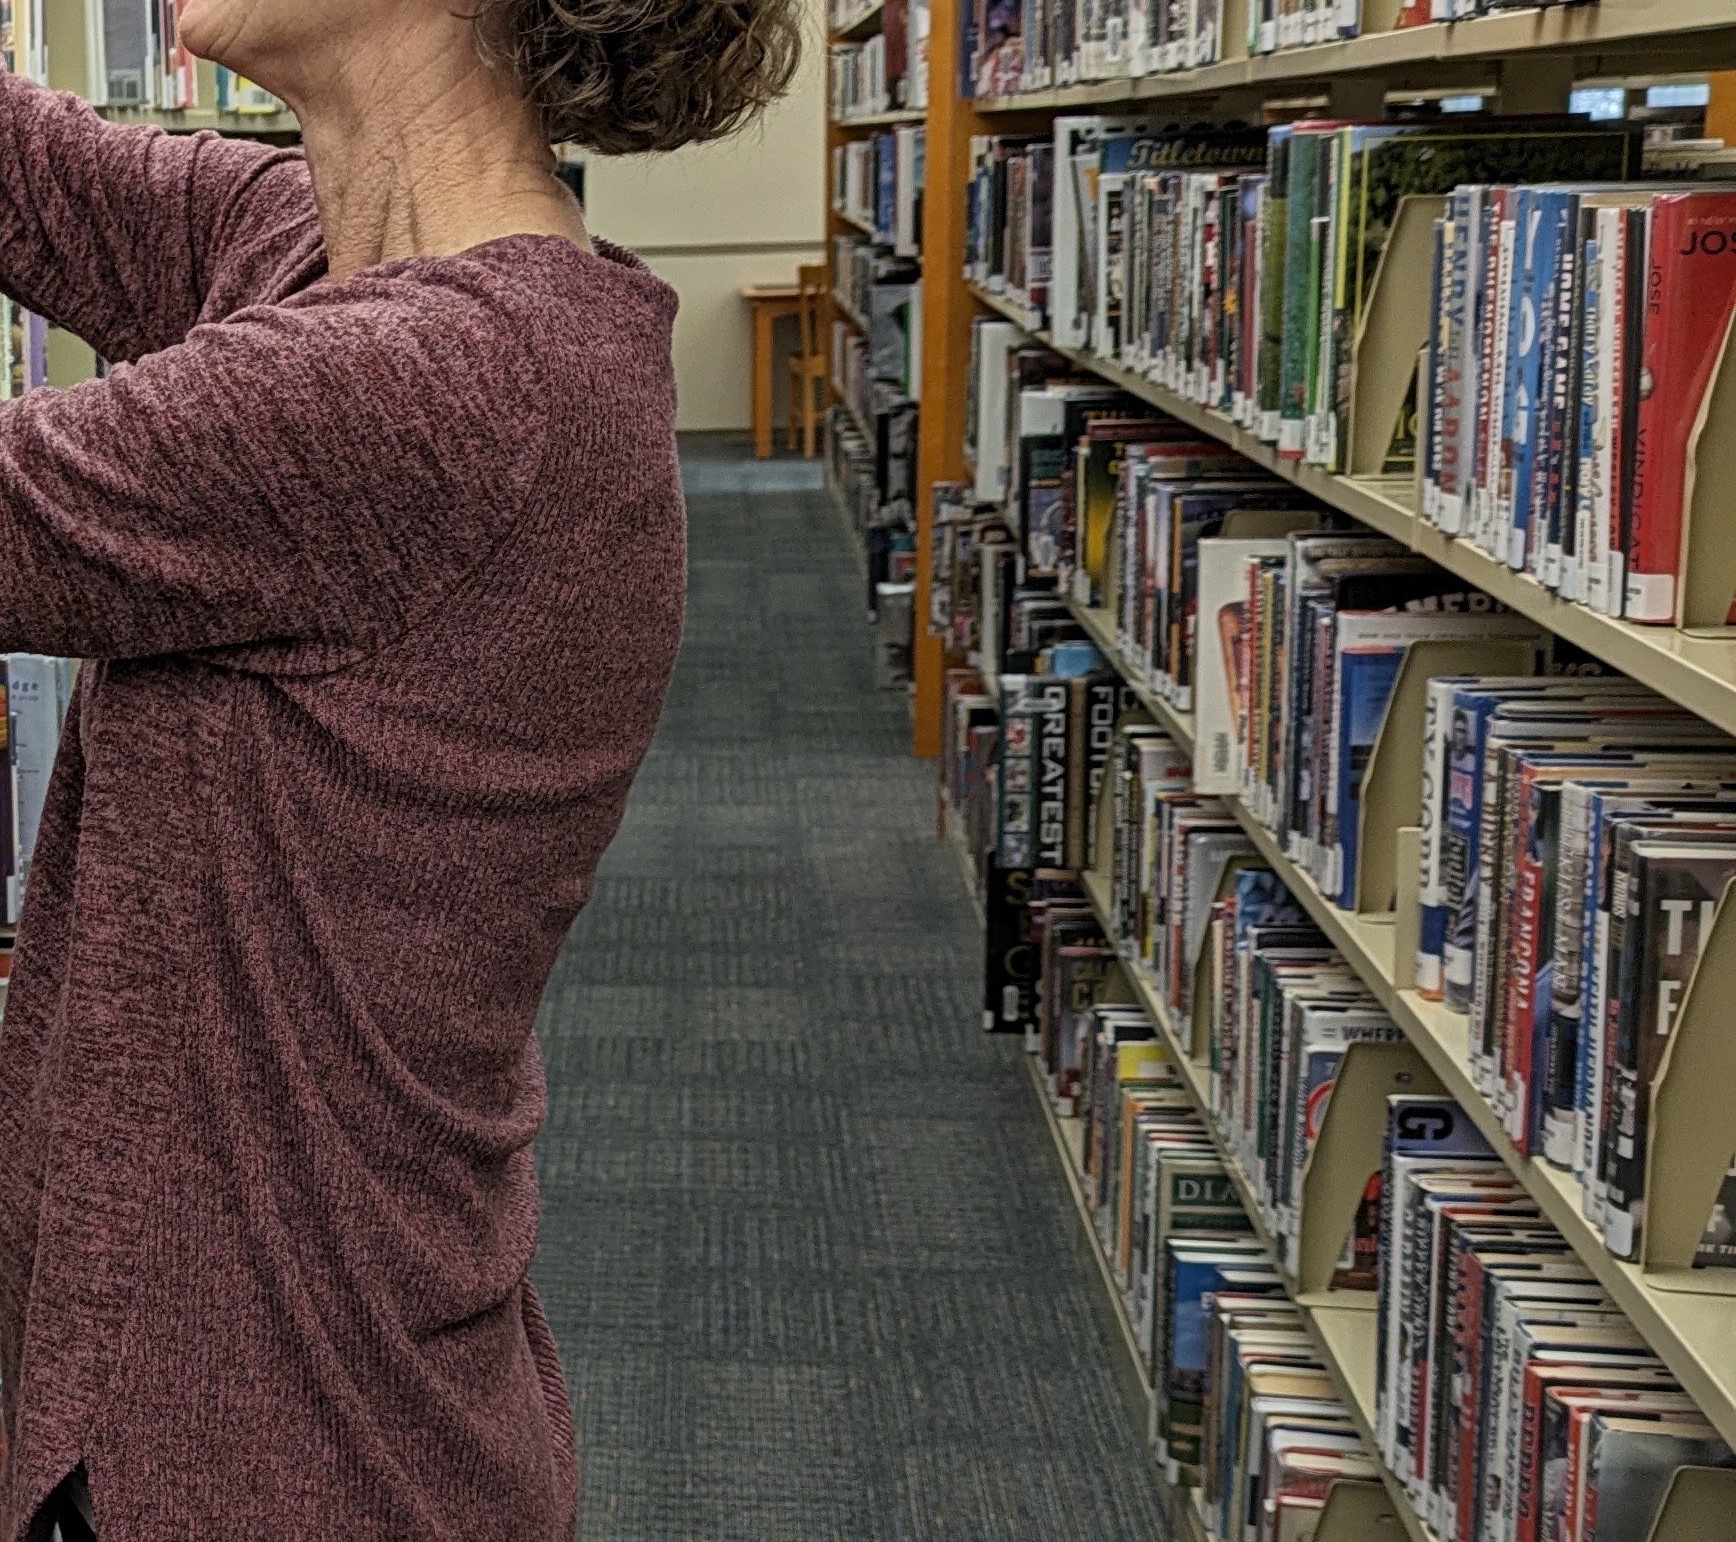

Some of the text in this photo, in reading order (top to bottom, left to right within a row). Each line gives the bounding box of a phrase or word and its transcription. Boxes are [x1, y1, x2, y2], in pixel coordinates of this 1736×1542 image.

[1553, 253, 1573, 411] HOME GAME
[1649, 264, 1662, 316] JOSE
[1632, 426, 1648, 571] VINDICAT
